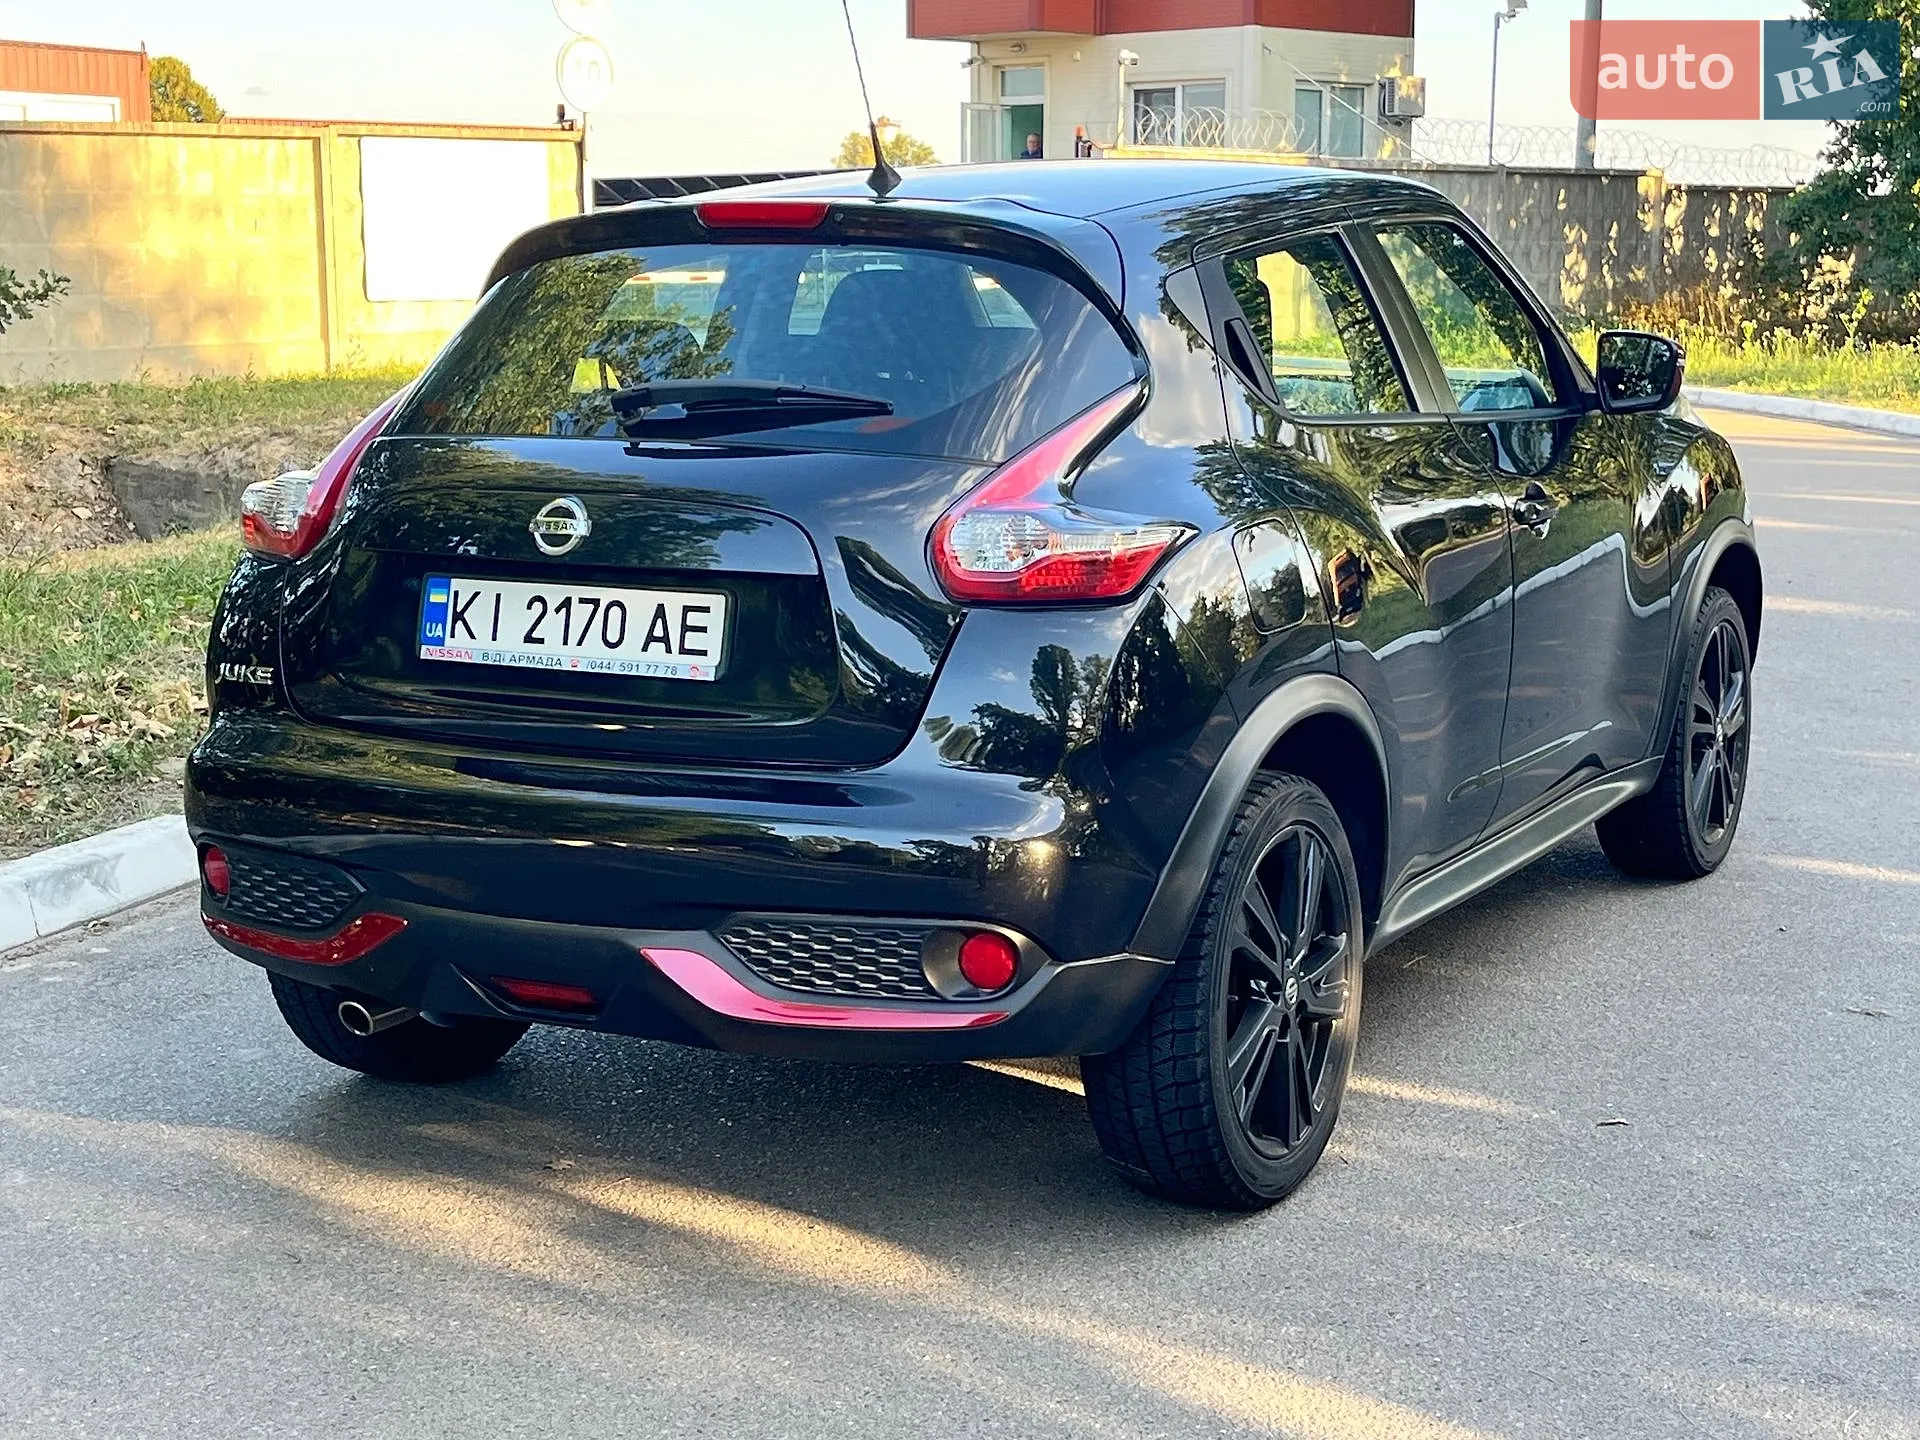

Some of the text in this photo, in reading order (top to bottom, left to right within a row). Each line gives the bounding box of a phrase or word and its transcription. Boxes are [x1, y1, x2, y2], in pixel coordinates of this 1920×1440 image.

[426, 621, 444, 638] UA
[522, 595, 627, 649] 2170
[641, 603, 711, 656] AE
[215, 662, 274, 685] JUKE
[425, 647, 473, 660] NISSAN
[619, 663, 640, 674] 591
[664, 665, 678, 677] 78
